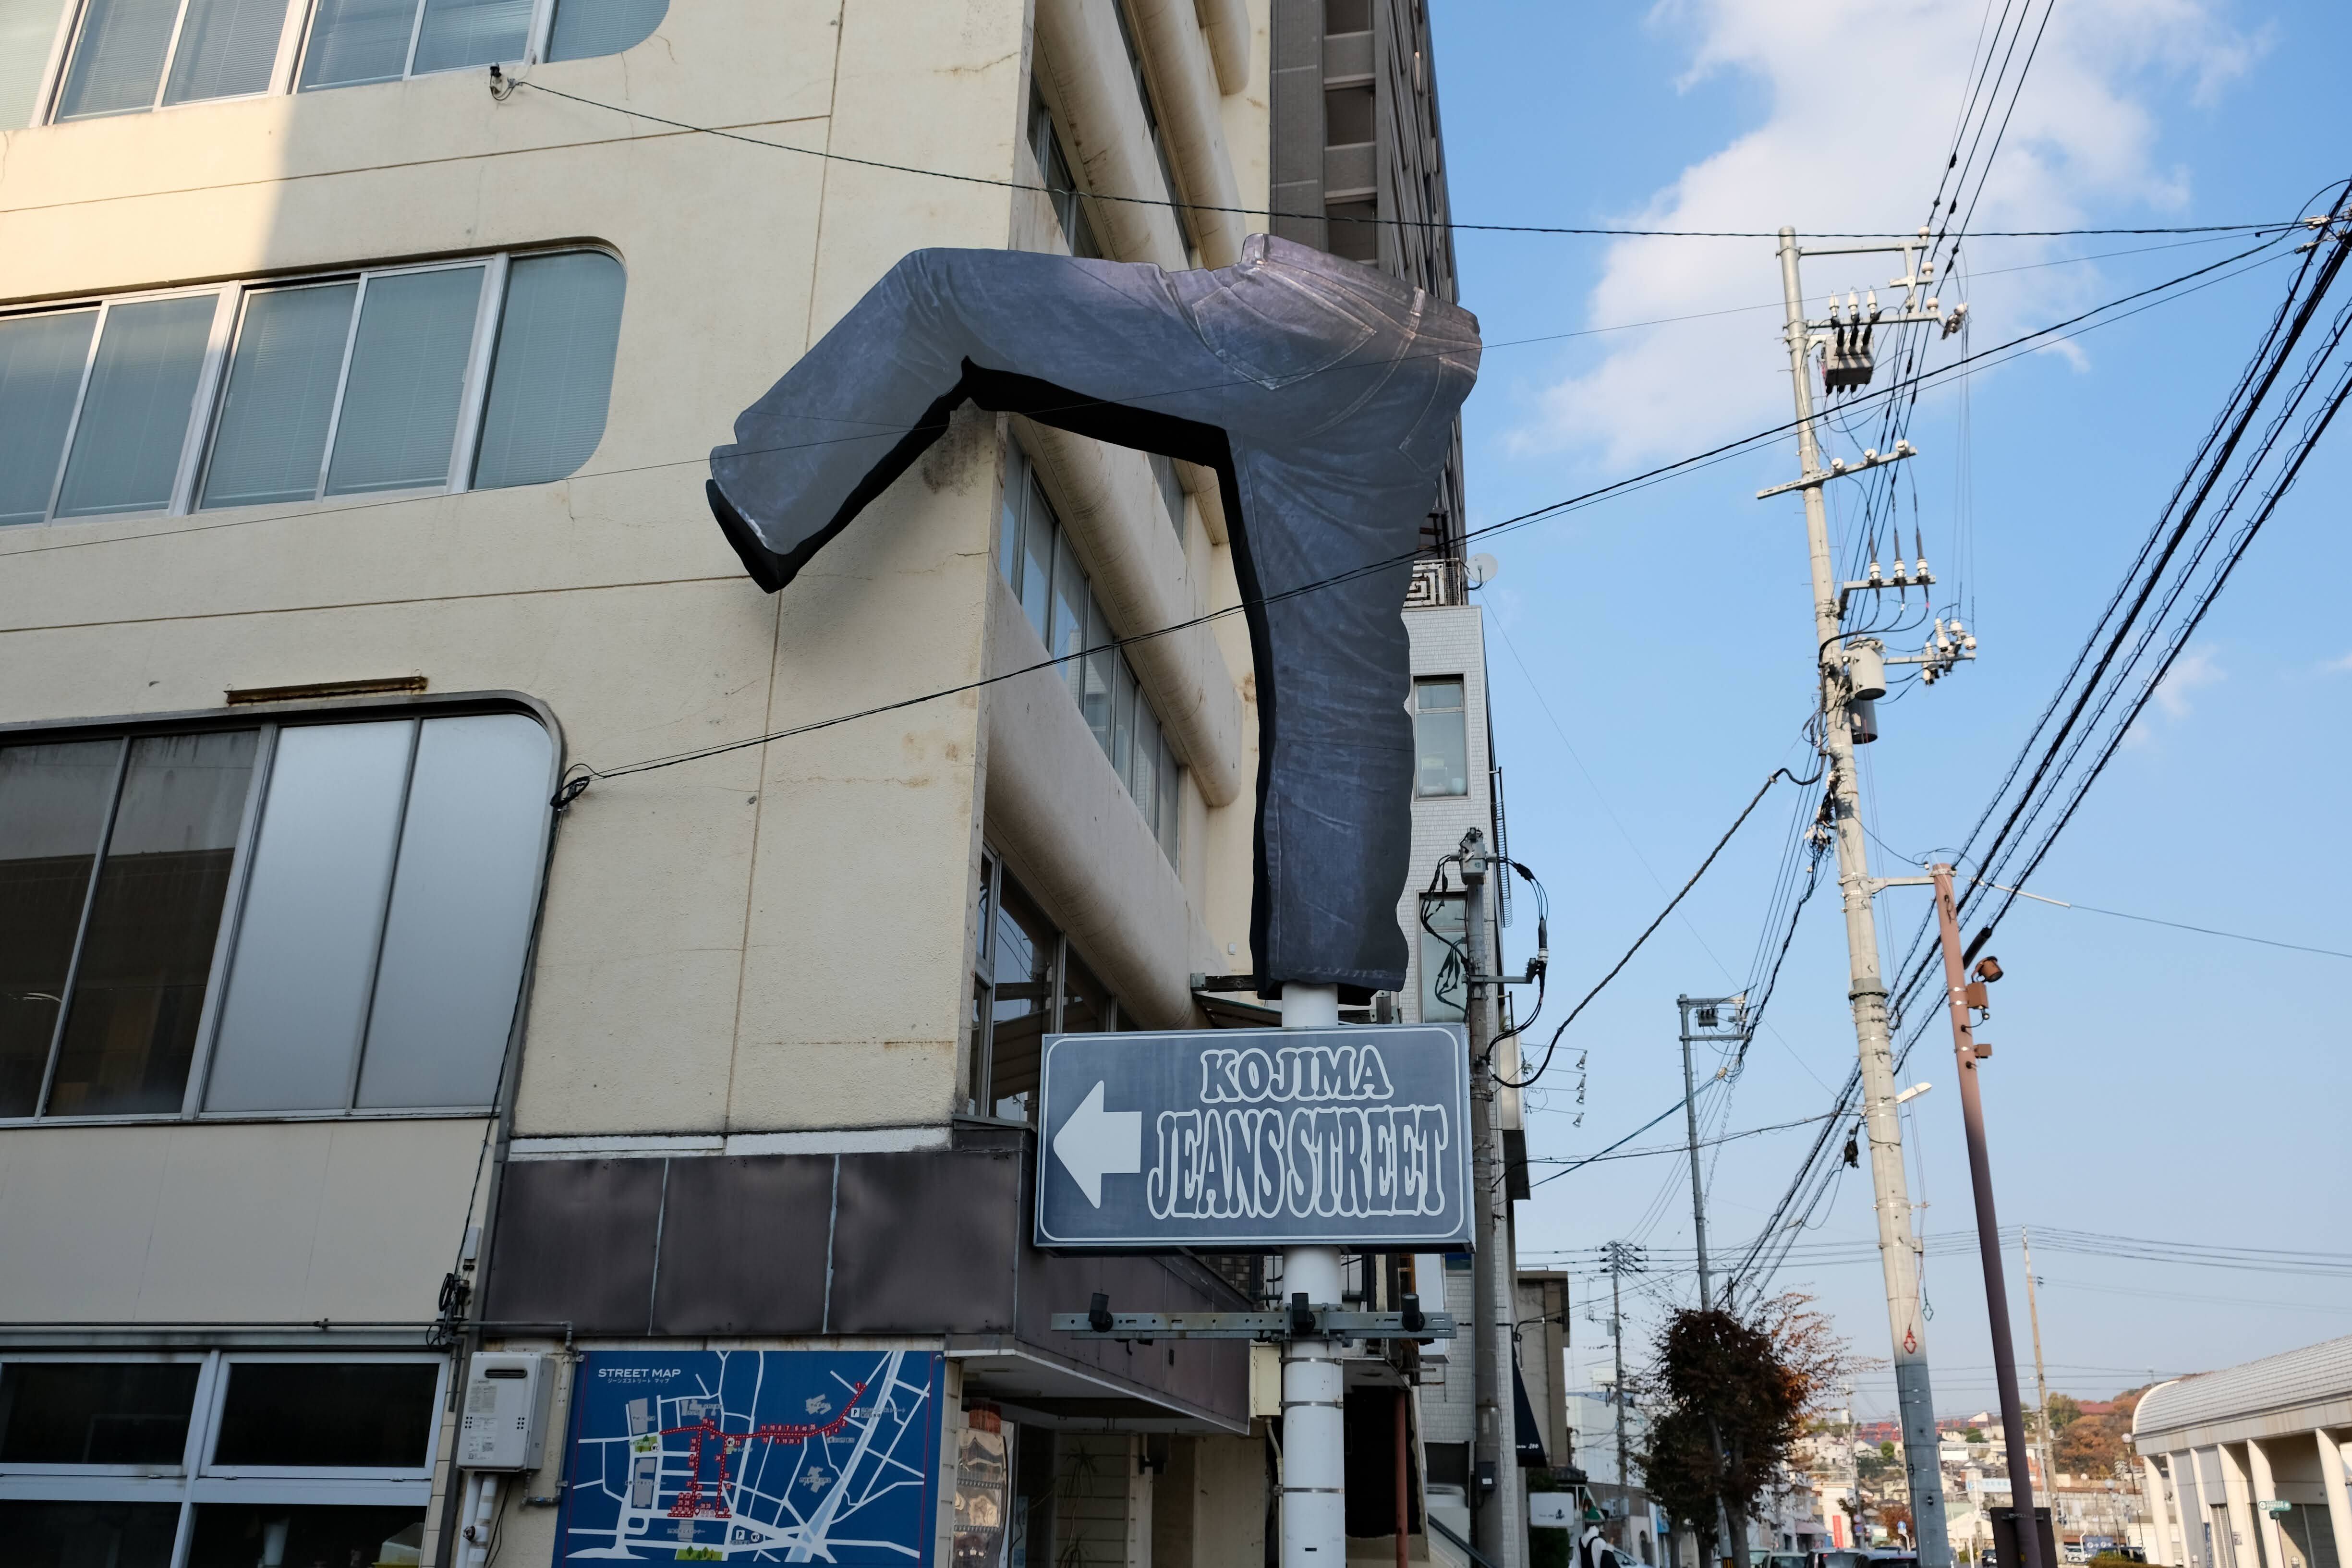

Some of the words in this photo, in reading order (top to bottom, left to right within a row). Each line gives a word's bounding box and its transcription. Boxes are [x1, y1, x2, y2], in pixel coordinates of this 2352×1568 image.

[1200, 1045, 1394, 1104] KOJIMA
[1147, 1108, 1285, 1220] JEANS
[1287, 1104, 1448, 1218] STREET
[598, 1369, 649, 1378] STREET
[652, 1369, 681, 1378] MAP
